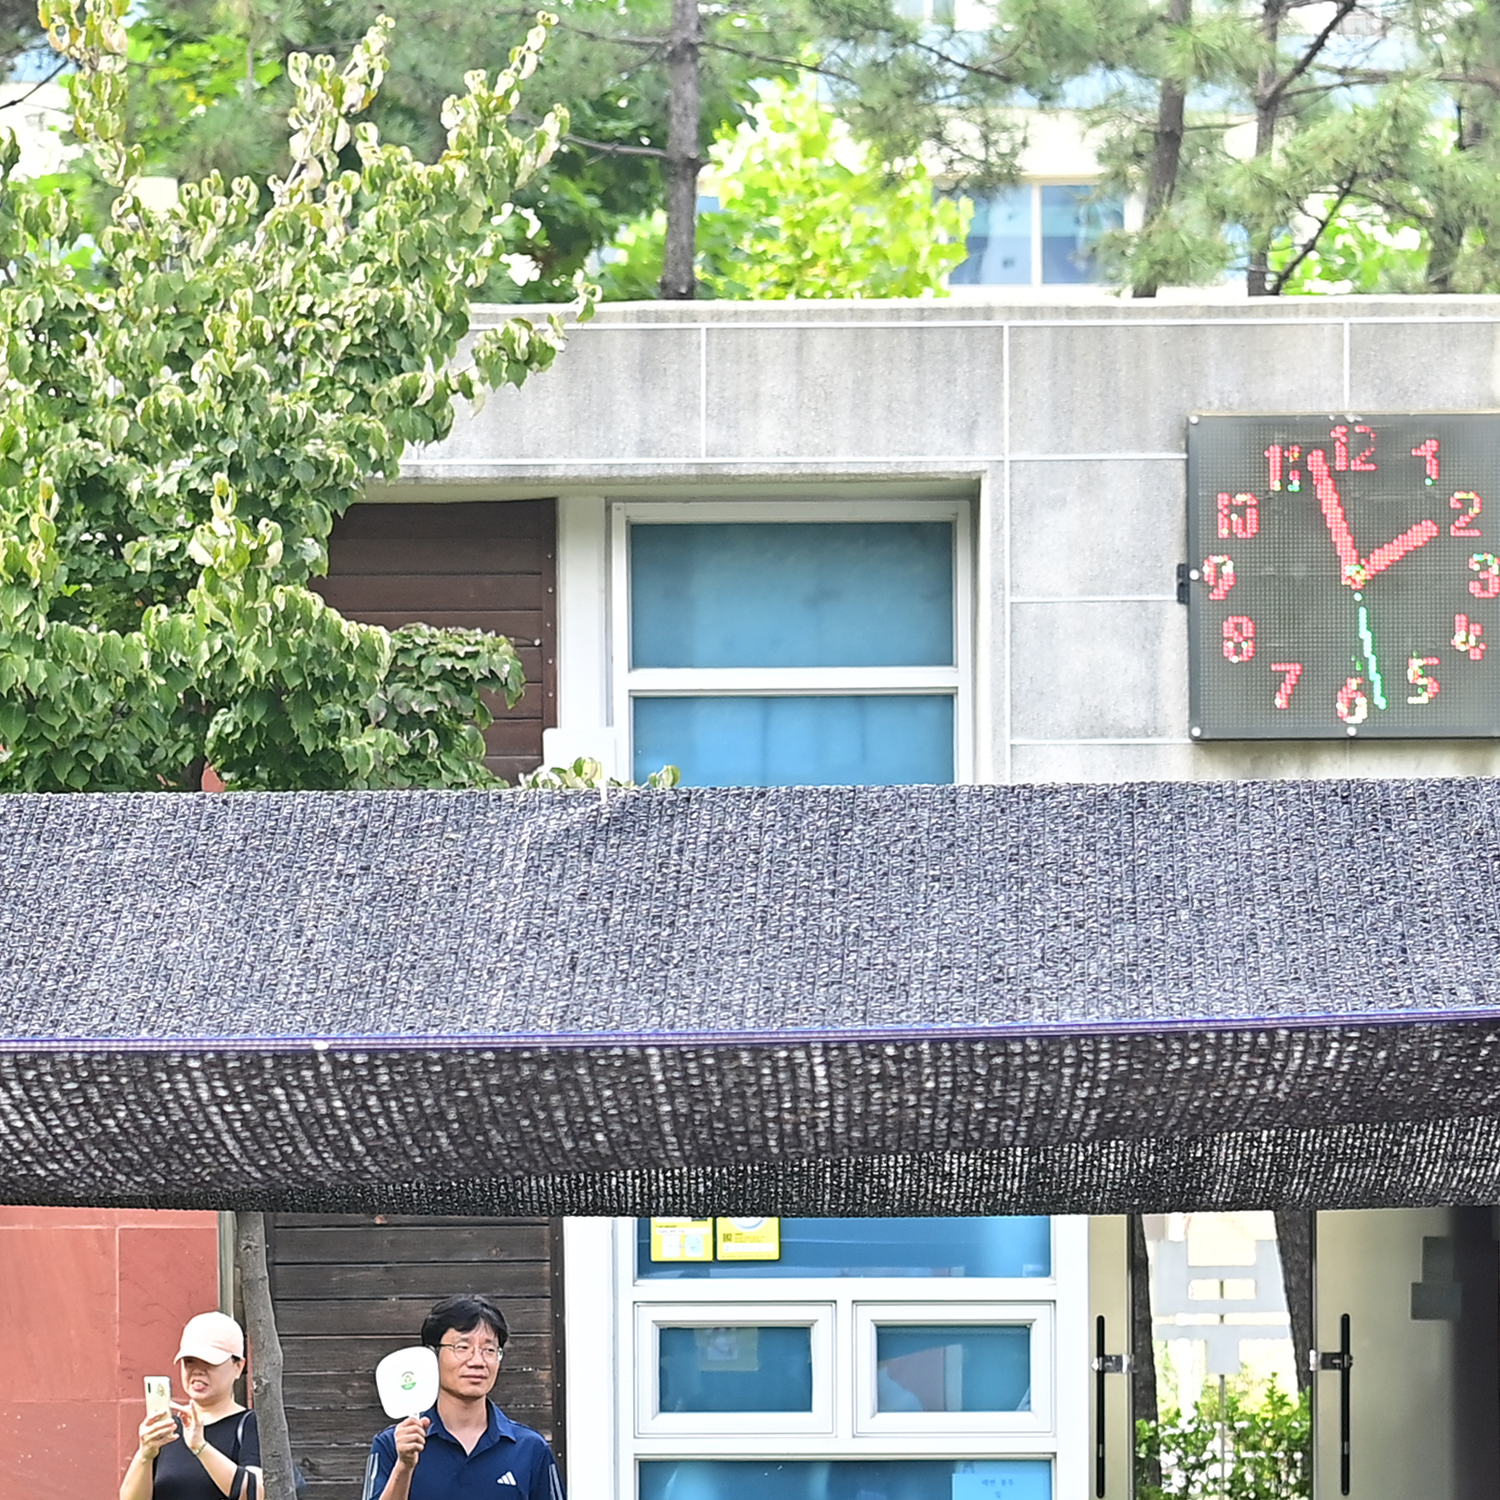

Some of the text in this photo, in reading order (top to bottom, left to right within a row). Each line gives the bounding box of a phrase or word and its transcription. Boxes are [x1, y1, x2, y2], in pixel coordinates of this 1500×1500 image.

[1330, 426, 1376, 471] 12
[1412, 439, 1439, 486] 1
[1217, 492, 1259, 538] 10
[1450, 491, 1481, 537] 2
[1203, 555, 1235, 600] 9
[1468, 552, 1500, 598] 3
[1222, 615, 1255, 662] 8
[1451, 613, 1487, 660] 4
[1270, 663, 1302, 709] 7
[1336, 677, 1367, 723] 6
[1407, 655, 1440, 704] 5
